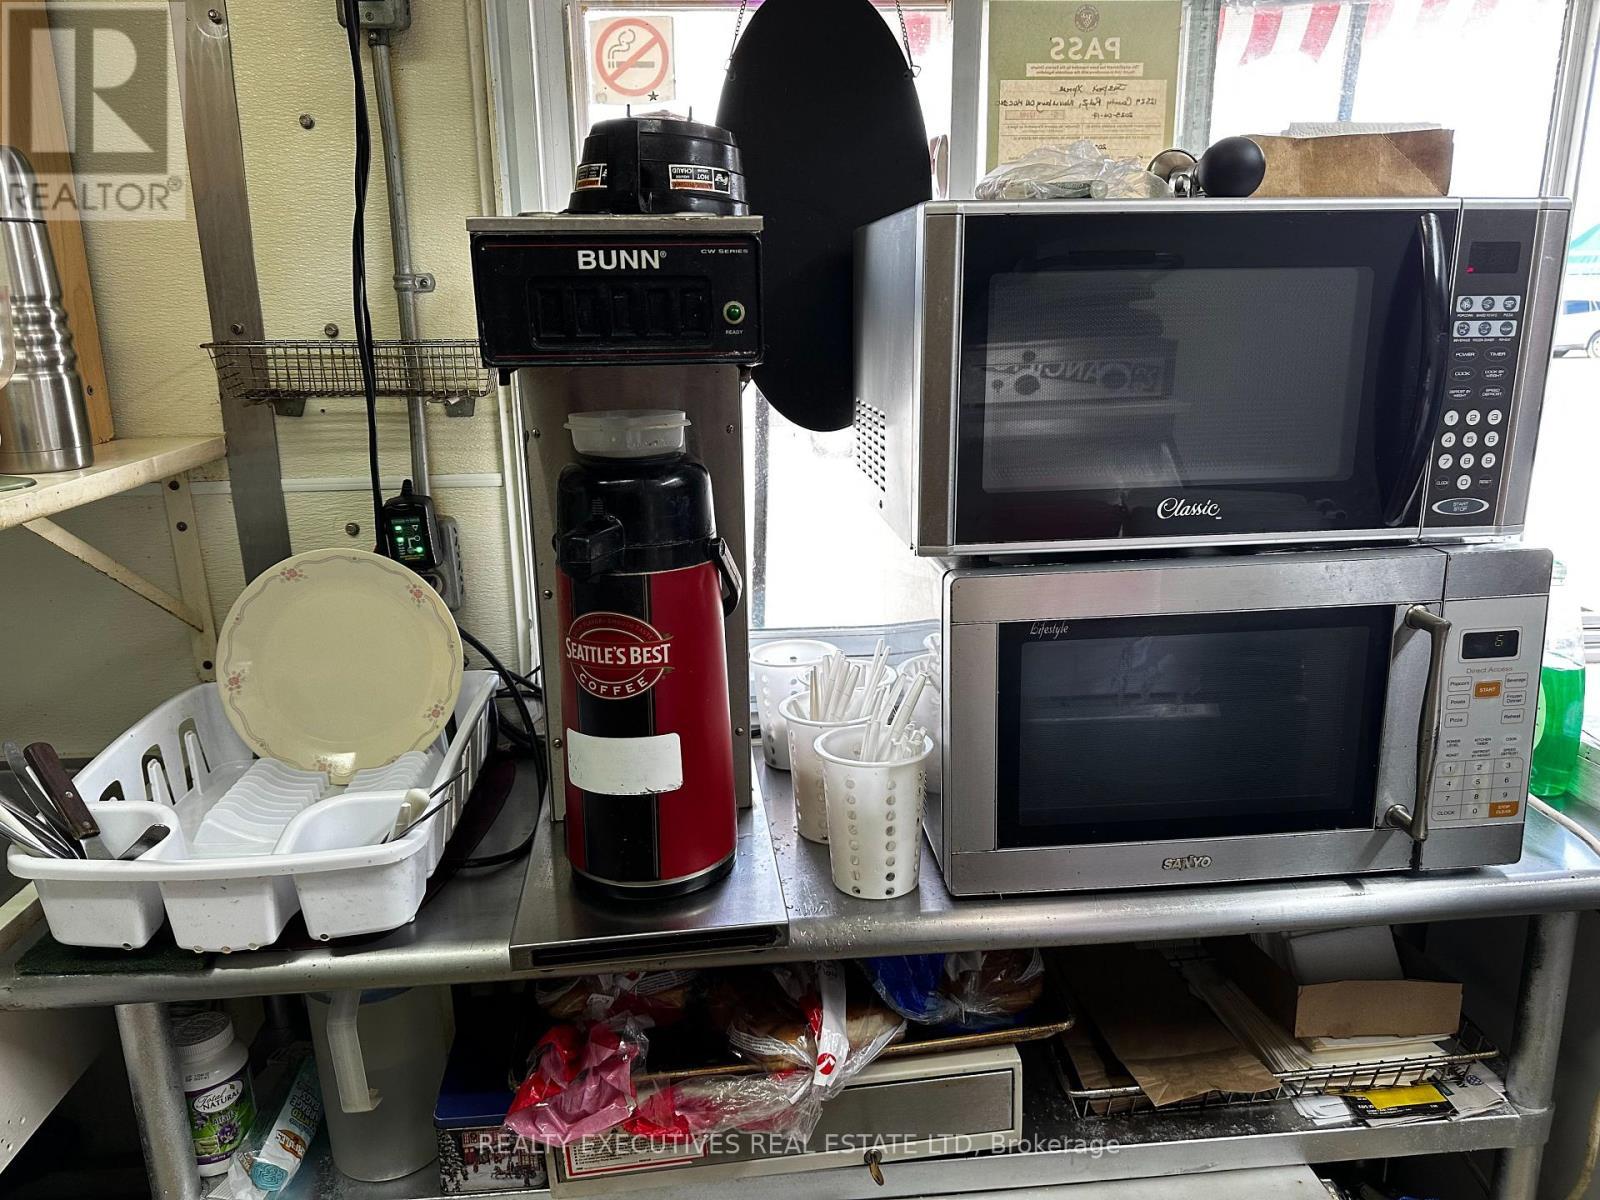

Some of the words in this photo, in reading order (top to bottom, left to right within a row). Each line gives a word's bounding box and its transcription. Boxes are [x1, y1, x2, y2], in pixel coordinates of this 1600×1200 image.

[1157, 498, 1221, 519] Classic
[1030, 621, 1069, 640] Lifestyle
[565, 637, 627, 664] SEATTLE'S
[630, 644, 671, 664] BEST
[579, 672, 649, 695] COFFEE
[1162, 855, 1212, 870] SANYO
[202, 1089, 239, 1110] NATURAL
